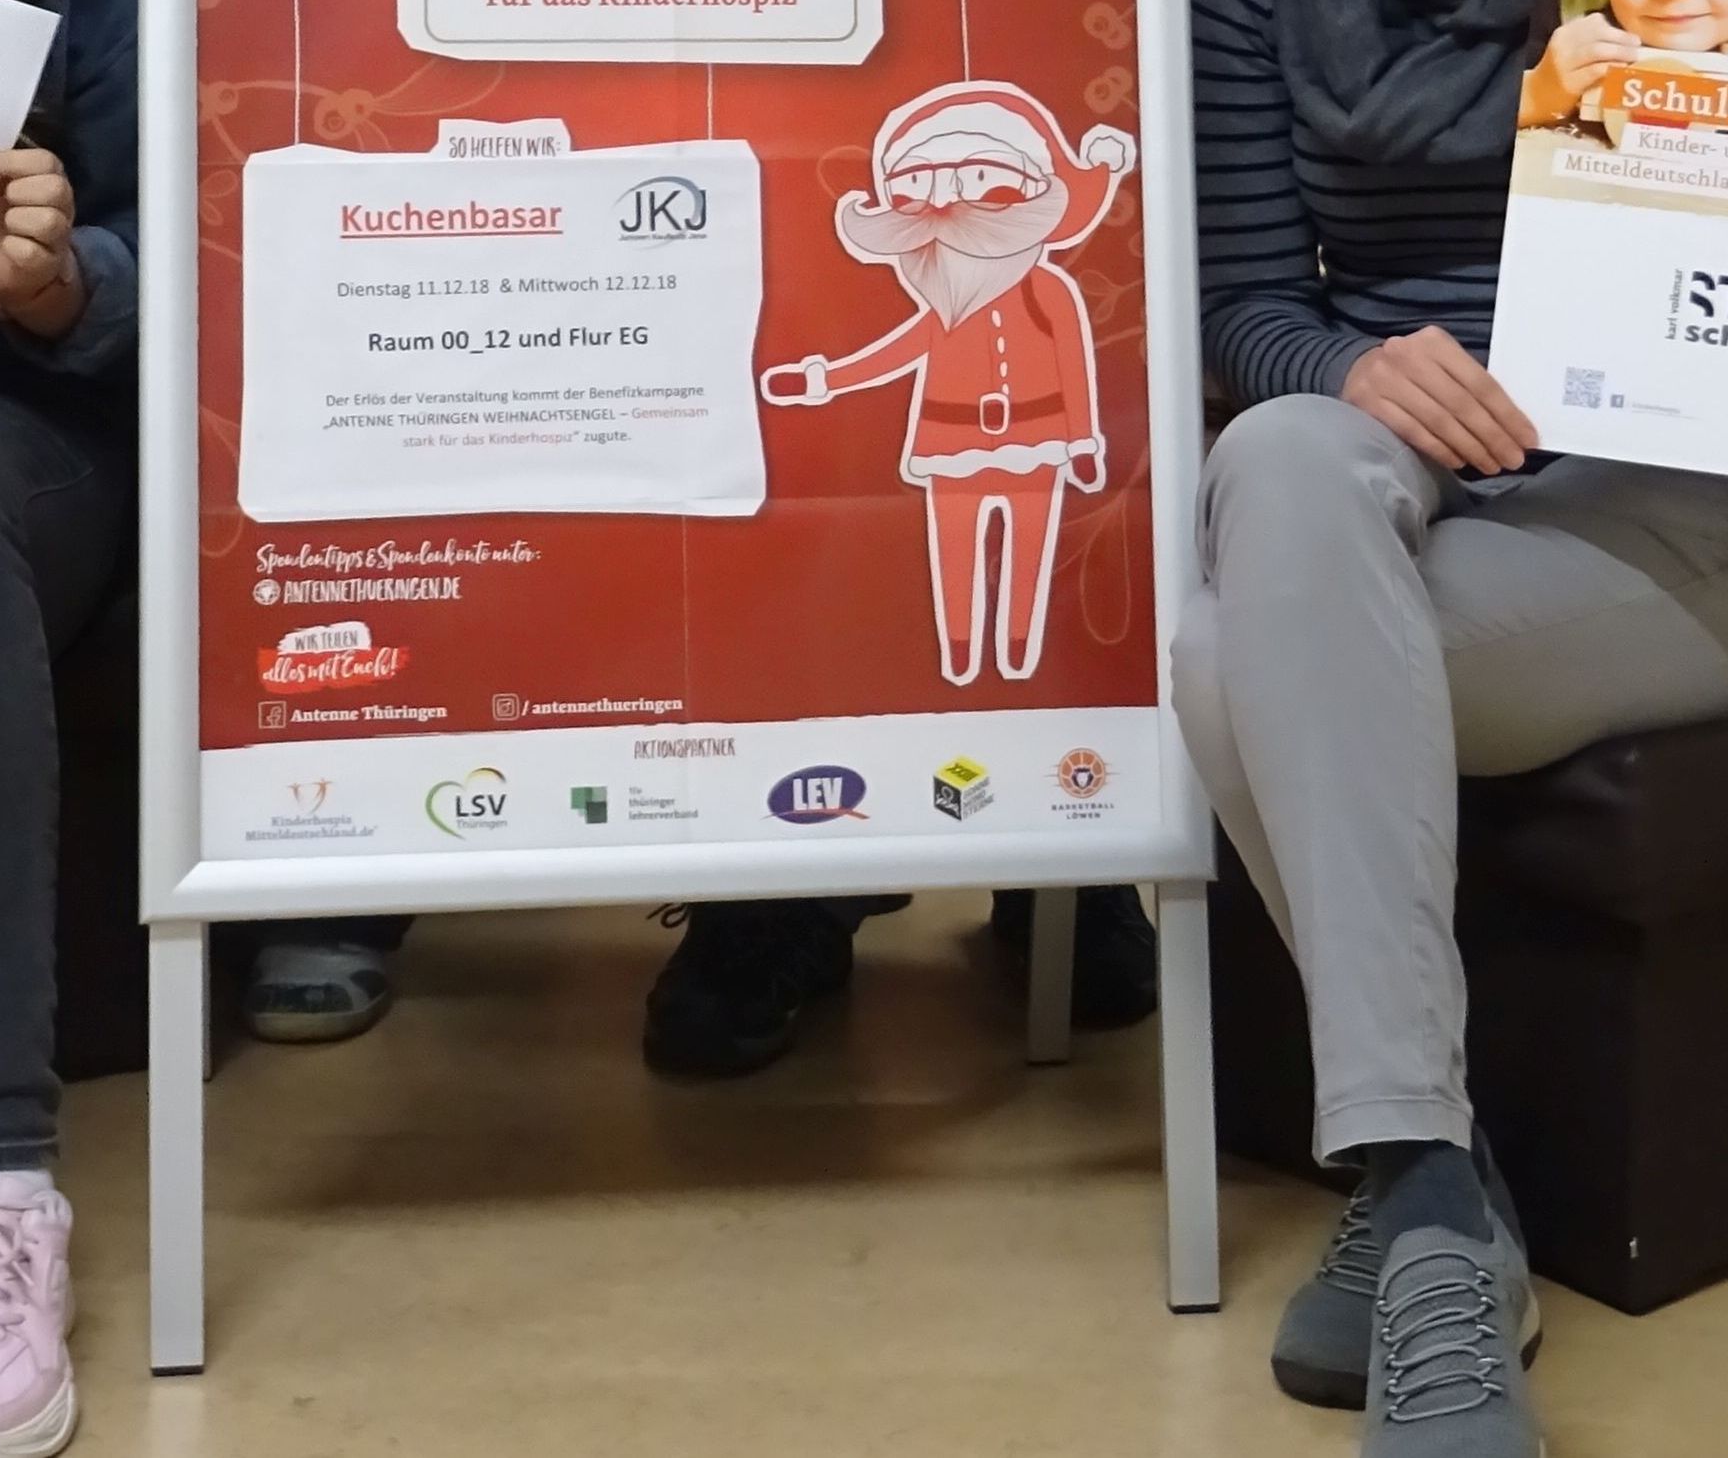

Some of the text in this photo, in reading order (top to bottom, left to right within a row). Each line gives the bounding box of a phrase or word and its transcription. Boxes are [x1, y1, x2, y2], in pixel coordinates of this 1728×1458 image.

[449, 136, 467, 158] SO
[471, 136, 523, 158] HELFEN
[1638, 132, 1718, 156] Kinder-
[339, 203, 563, 235] Kuchenbasar
[619, 189, 707, 232] JKJ
[337, 274, 677, 300] Dienstag 11.12.18 & Mittwoch 12.12.18
[368, 326, 649, 354] Raum 00_12 und Flur EG
[326, 384, 705, 408] Der Erlös der Veranstaltung kommt der Benefizkampagne
[400, 411, 479, 427] THÜRINGEN
[483, 408, 616, 425] WEIHNACHTSENGEL
[631, 406, 709, 421] Gemeinsam
[402, 434, 435, 448] stark
[462, 432, 485, 446] das
[583, 430, 633, 445] zugute.
[256, 543, 363, 574] Spendentipps
[377, 540, 490, 572] Spendenkonto
[491, 540, 542, 564] unter:
[283, 576, 462, 604] ANTENNETHUERINGEN.DE
[262, 656, 305, 684] alles
[340, 647, 399, 679] Euch!
[290, 705, 448, 724] Antenne Thüringen
[531, 697, 683, 716] antennethueringen
[633, 737, 736, 760] AKTIONSPARTNER
[455, 793, 507, 818] LSV
[792, 777, 843, 811] LEV
[1050, 802, 1116, 812] BASKETBALL
[456, 818, 508, 831] Thüringen
